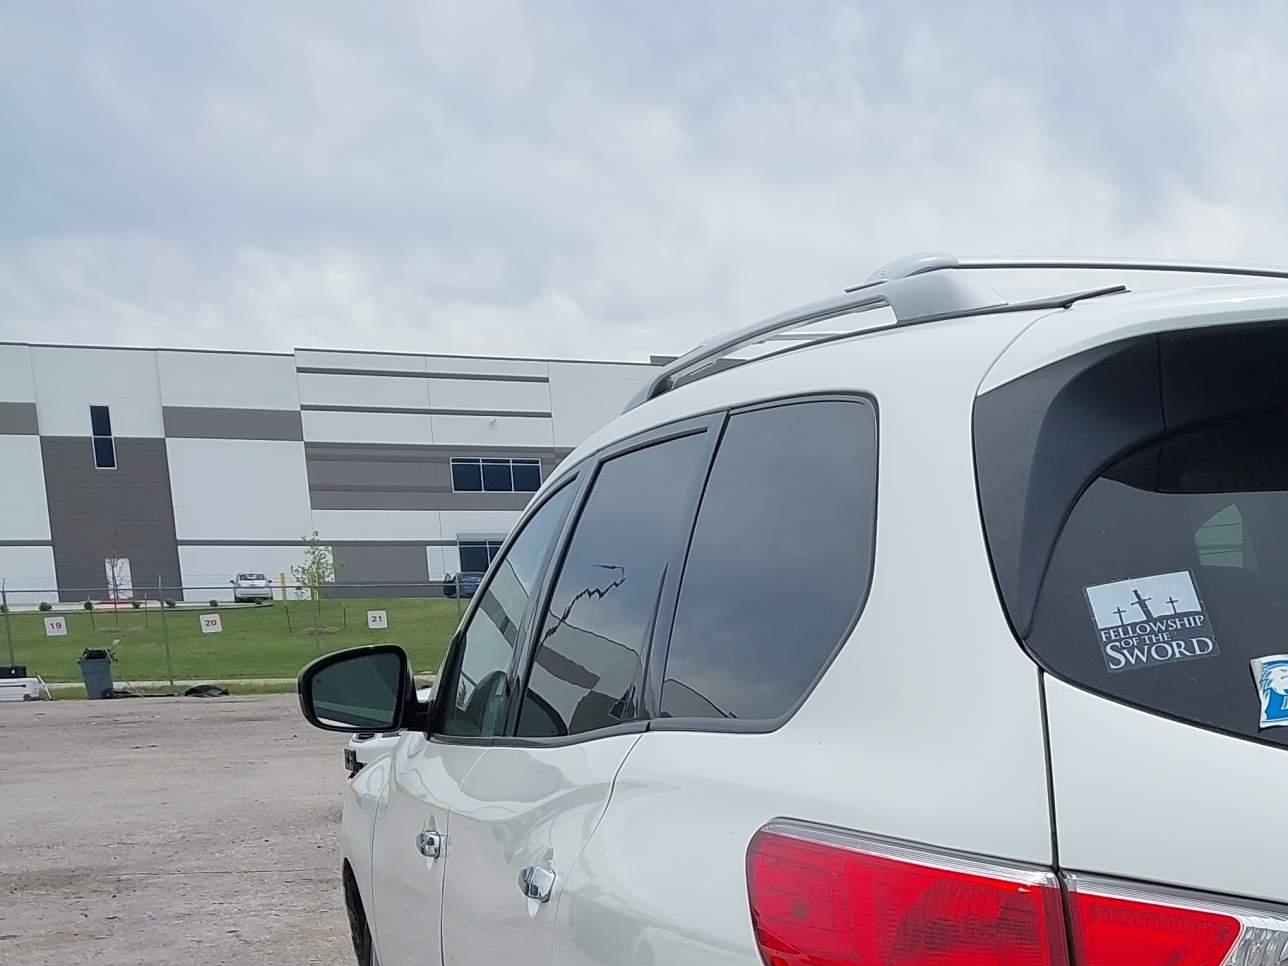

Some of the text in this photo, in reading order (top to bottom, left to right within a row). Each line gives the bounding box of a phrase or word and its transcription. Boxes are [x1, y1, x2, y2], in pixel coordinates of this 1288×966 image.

[204, 619, 217, 627] 20
[371, 615, 383, 623] 21
[49, 622, 62, 630] 19
[1100, 614, 1205, 643] FELLOWSHIP
[1121, 630, 1172, 649] OF THE
[1105, 636, 1215, 671] SWORD
